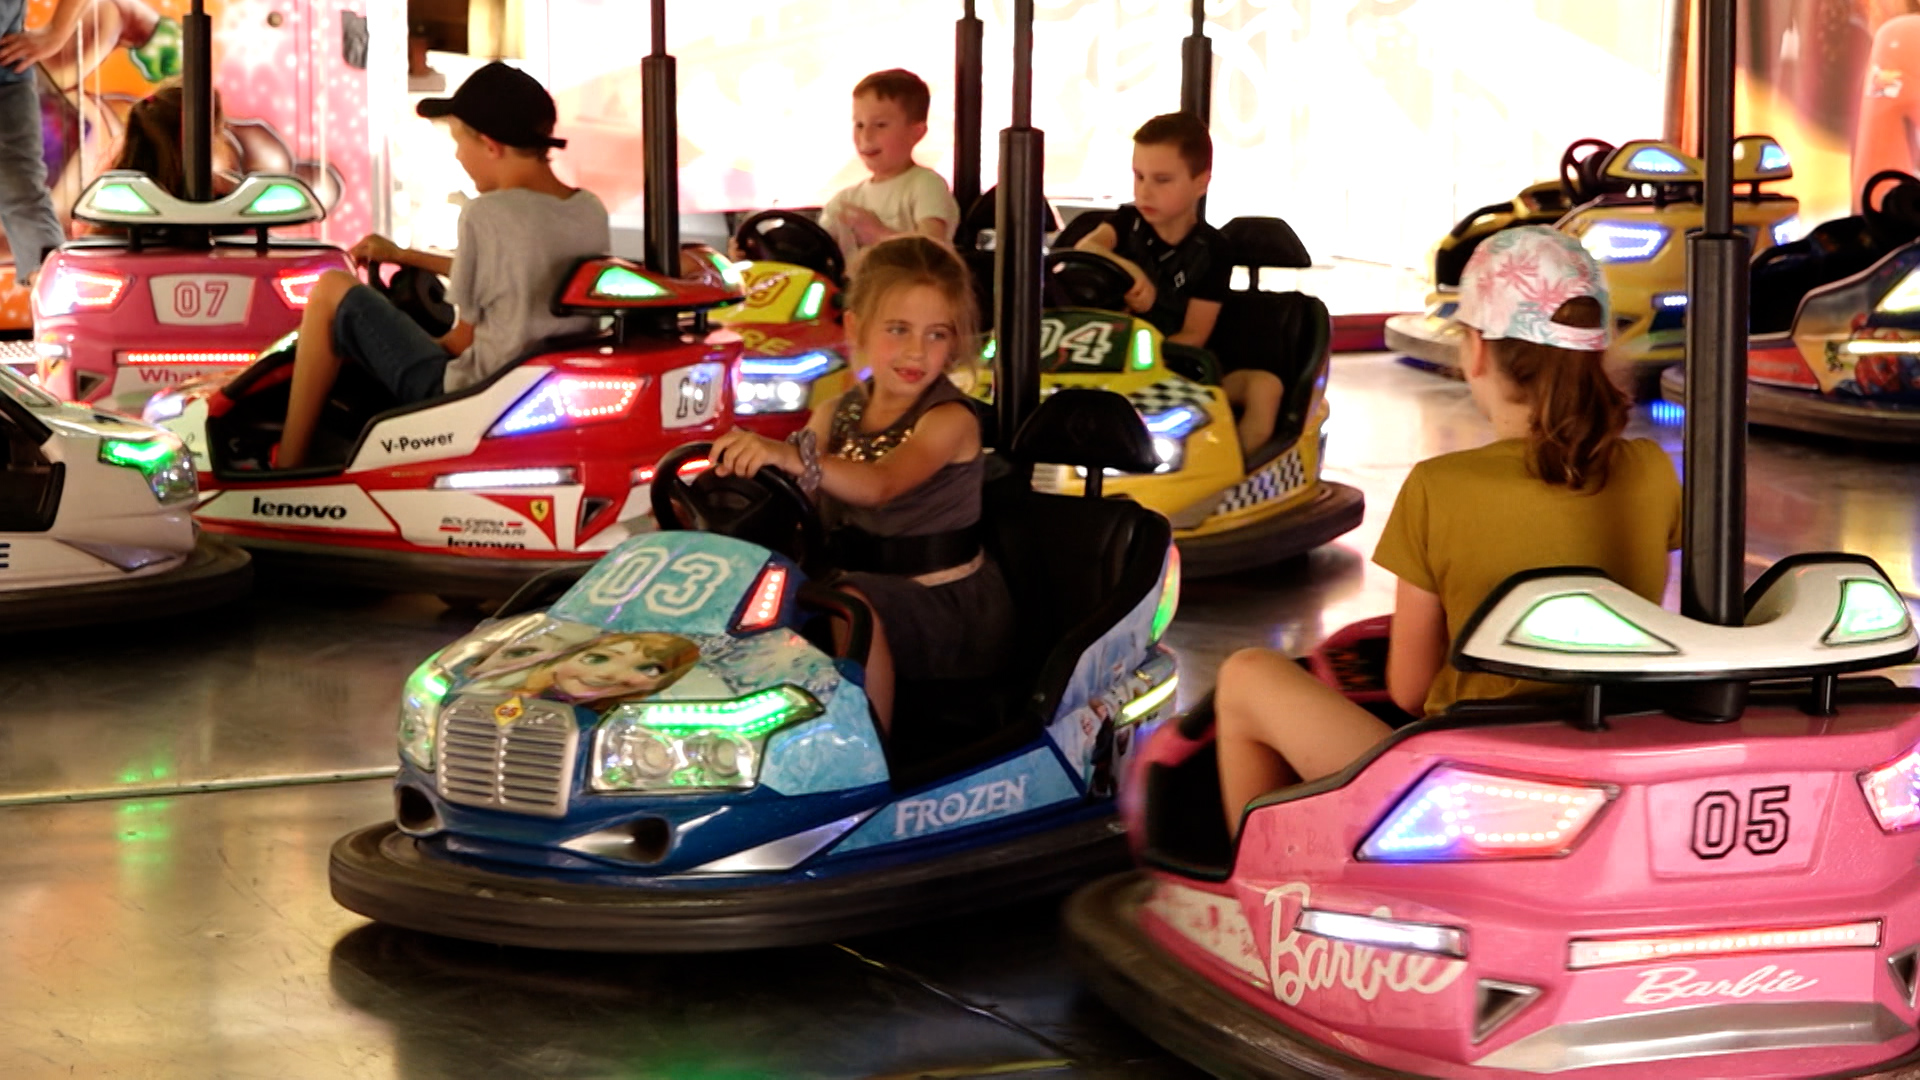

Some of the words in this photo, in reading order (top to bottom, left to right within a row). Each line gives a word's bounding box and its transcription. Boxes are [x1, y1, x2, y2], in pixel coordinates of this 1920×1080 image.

[174, 281, 229, 318] 07
[381, 432, 454, 454] V-Power
[252, 496, 347, 520] lenovo
[589, 546, 731, 616] 03
[893, 775, 1029, 837] FROZEN
[1689, 785, 1790, 860] 05
[1623, 965, 1819, 1004] Barbie
